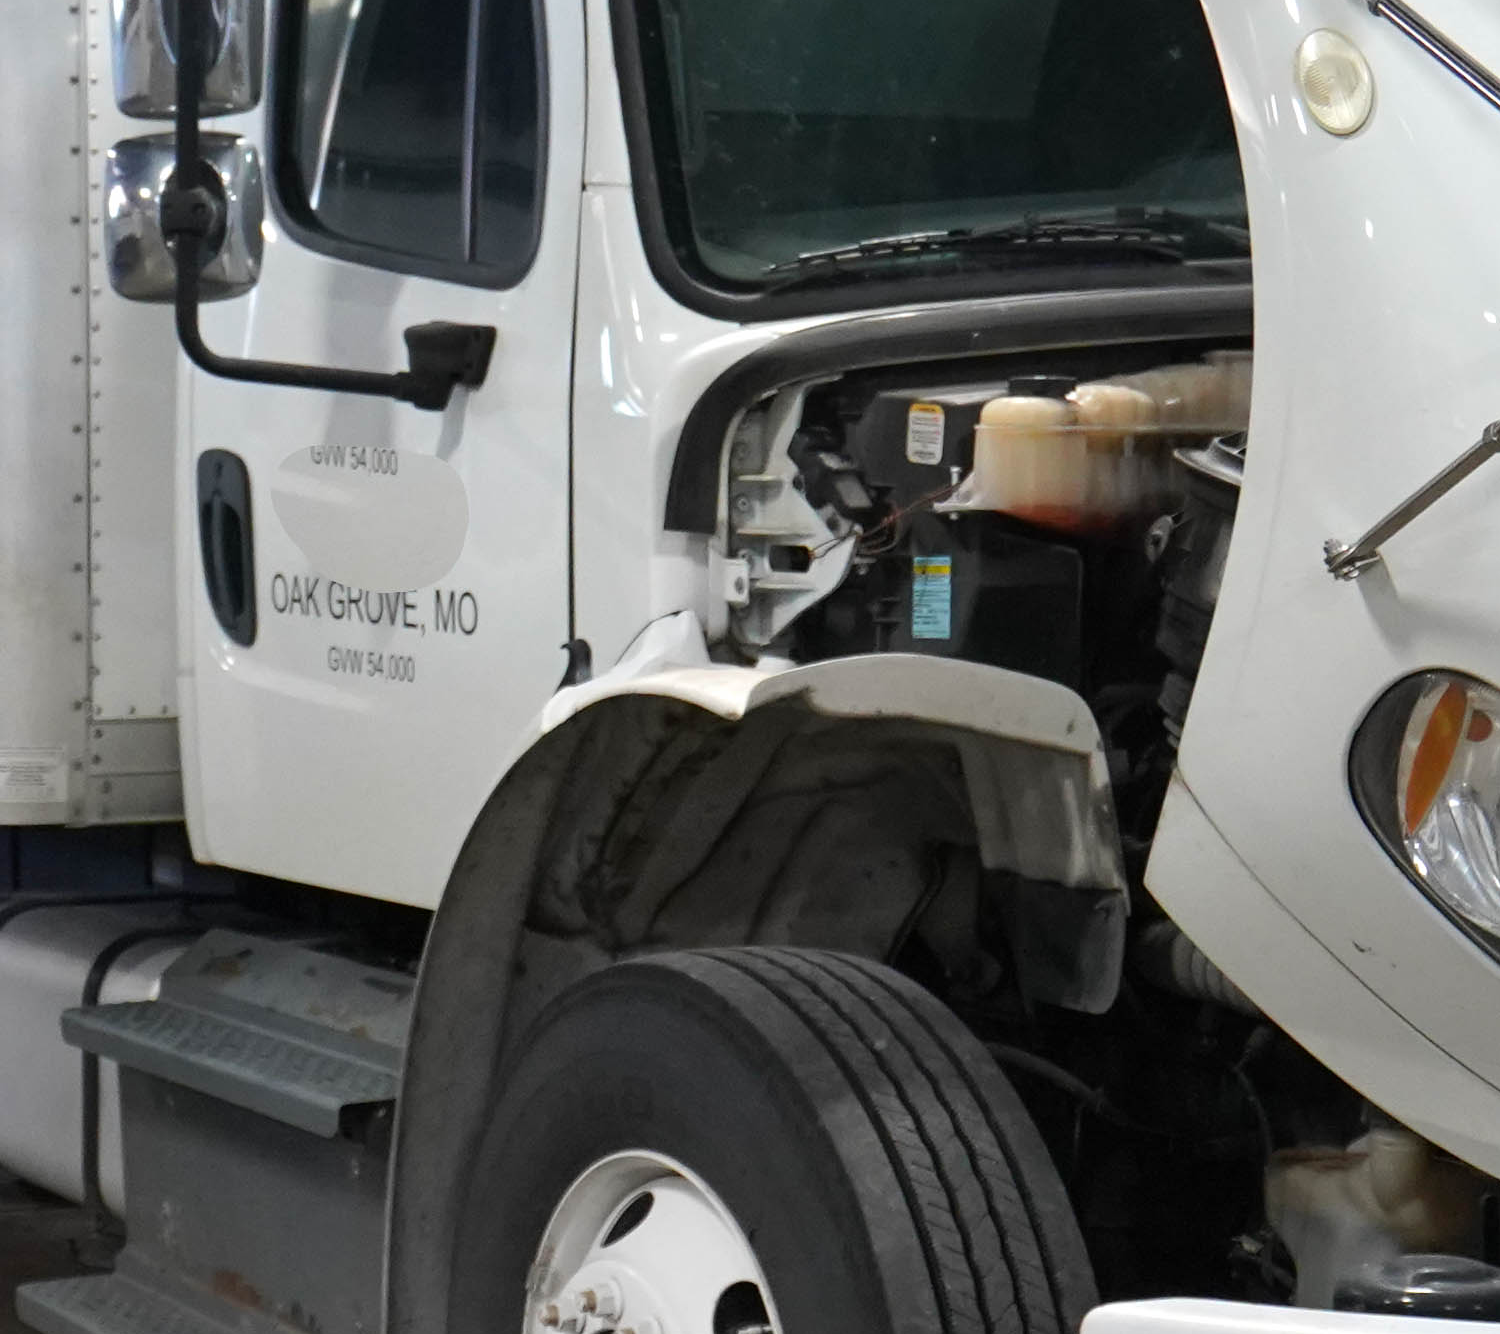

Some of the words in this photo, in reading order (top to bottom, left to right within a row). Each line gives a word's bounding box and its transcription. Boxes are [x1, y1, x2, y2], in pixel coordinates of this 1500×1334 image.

[310, 445, 346, 468] GVW
[271, 573, 321, 618] OAK
[327, 580, 426, 637] GROVE,
[435, 589, 478, 635] MO
[327, 646, 363, 675] GVW
[367, 651, 415, 683] 54,000
